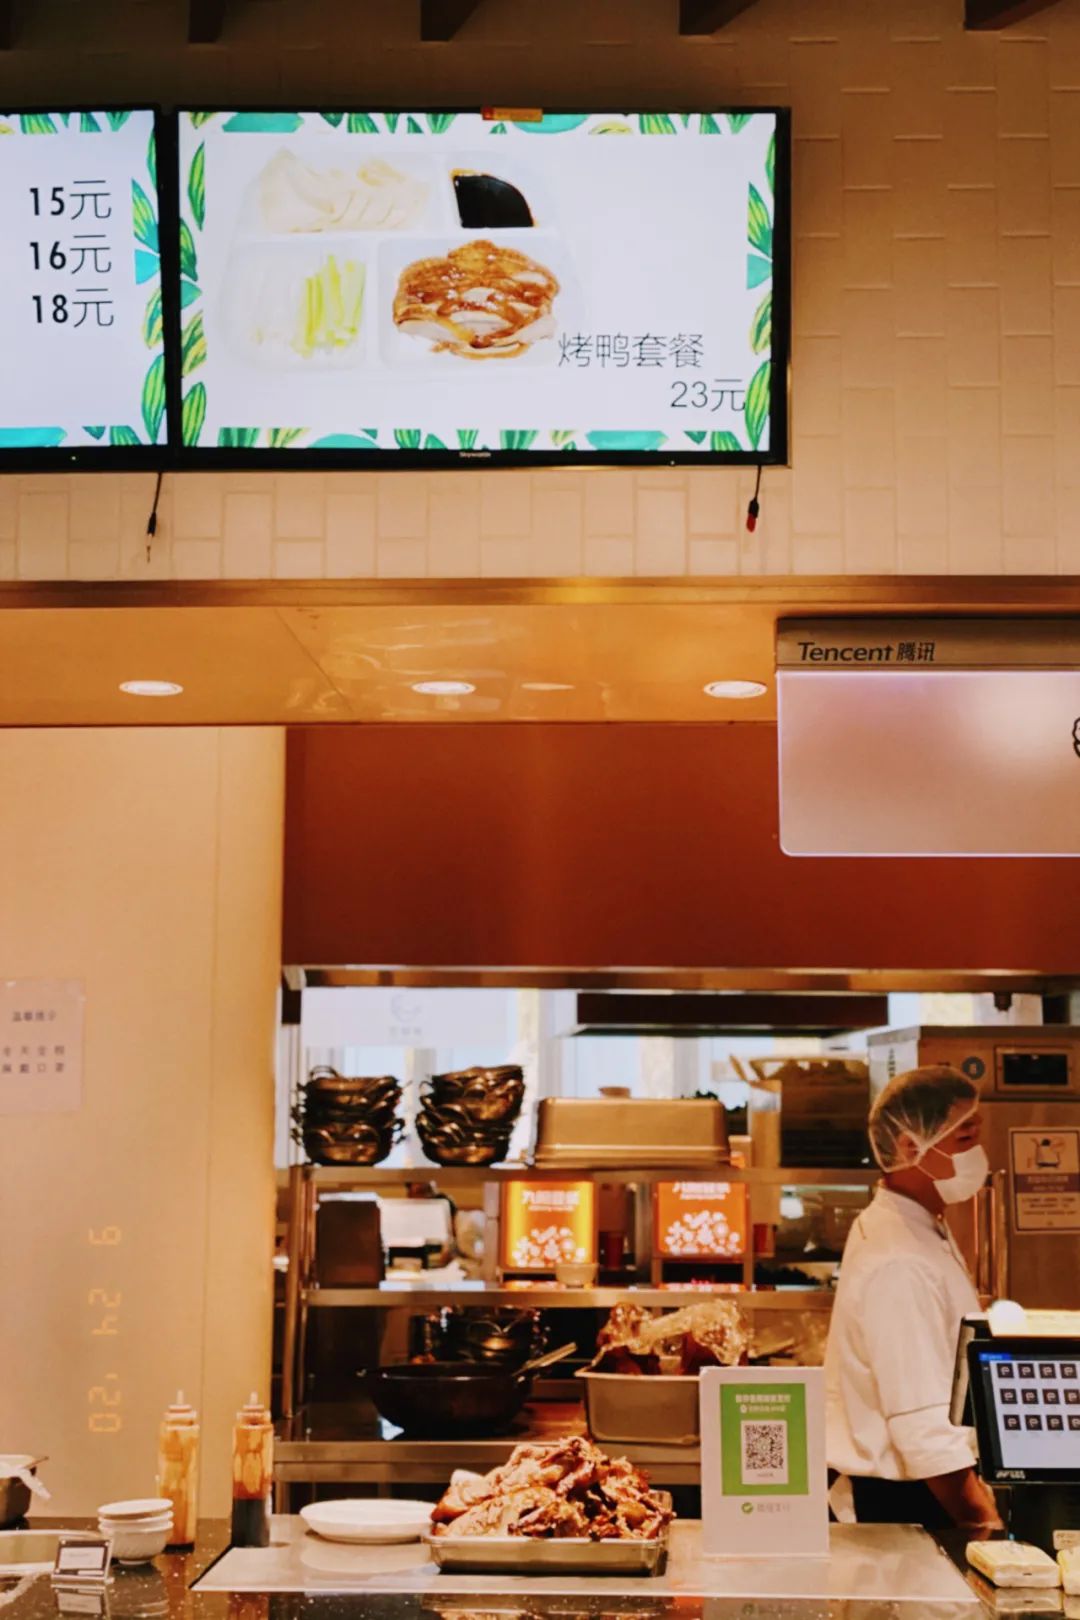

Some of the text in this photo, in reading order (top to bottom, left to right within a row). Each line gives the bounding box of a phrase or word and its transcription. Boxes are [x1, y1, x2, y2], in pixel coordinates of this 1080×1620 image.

[29, 180, 112, 220] 15元
[29, 234, 112, 275] 16元
[32, 288, 114, 328] 18元
[558, 332, 704, 368] 烤鸭套餐
[670, 378, 746, 412] 23元
[797, 642, 935, 662] Tencent 腾讯
